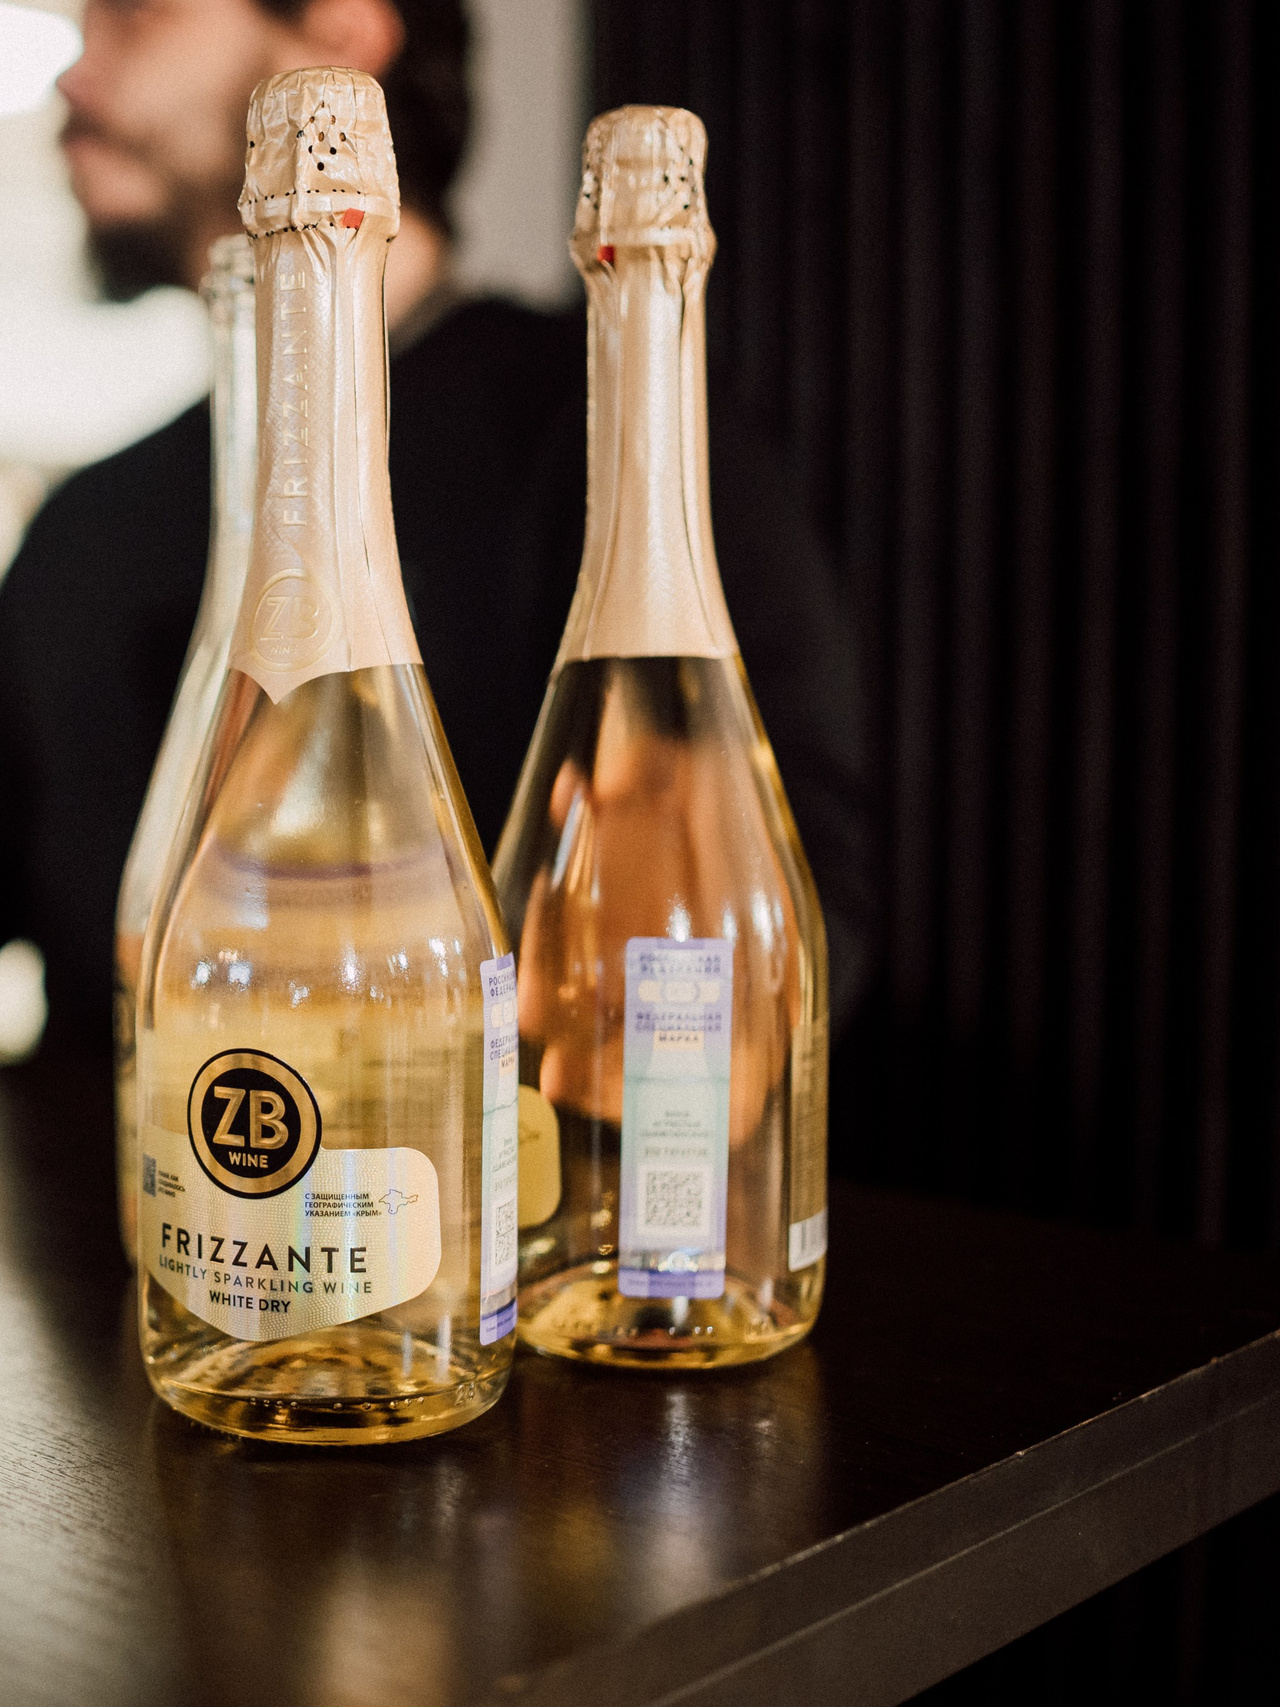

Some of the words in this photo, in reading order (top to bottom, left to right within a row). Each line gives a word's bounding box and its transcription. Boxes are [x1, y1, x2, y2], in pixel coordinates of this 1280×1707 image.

[279, 271, 309, 527] FRIZZANTE
[212, 1085, 289, 1150] ZB
[228, 1151, 269, 1169] WINE
[305, 1201, 374, 1209] ГЕОГРАФИЧЕСКИМ
[311, 1193, 369, 1201] ЗАЩИЩЕННЫМ
[162, 1223, 367, 1274] FRIZZANTE
[159, 1254, 207, 1280] LIGHTLY
[214, 1272, 313, 1294] SPARKLING
[324, 1281, 372, 1294] WINE
[209, 1290, 254, 1310] WHITE
[259, 1299, 291, 1314] DRY
